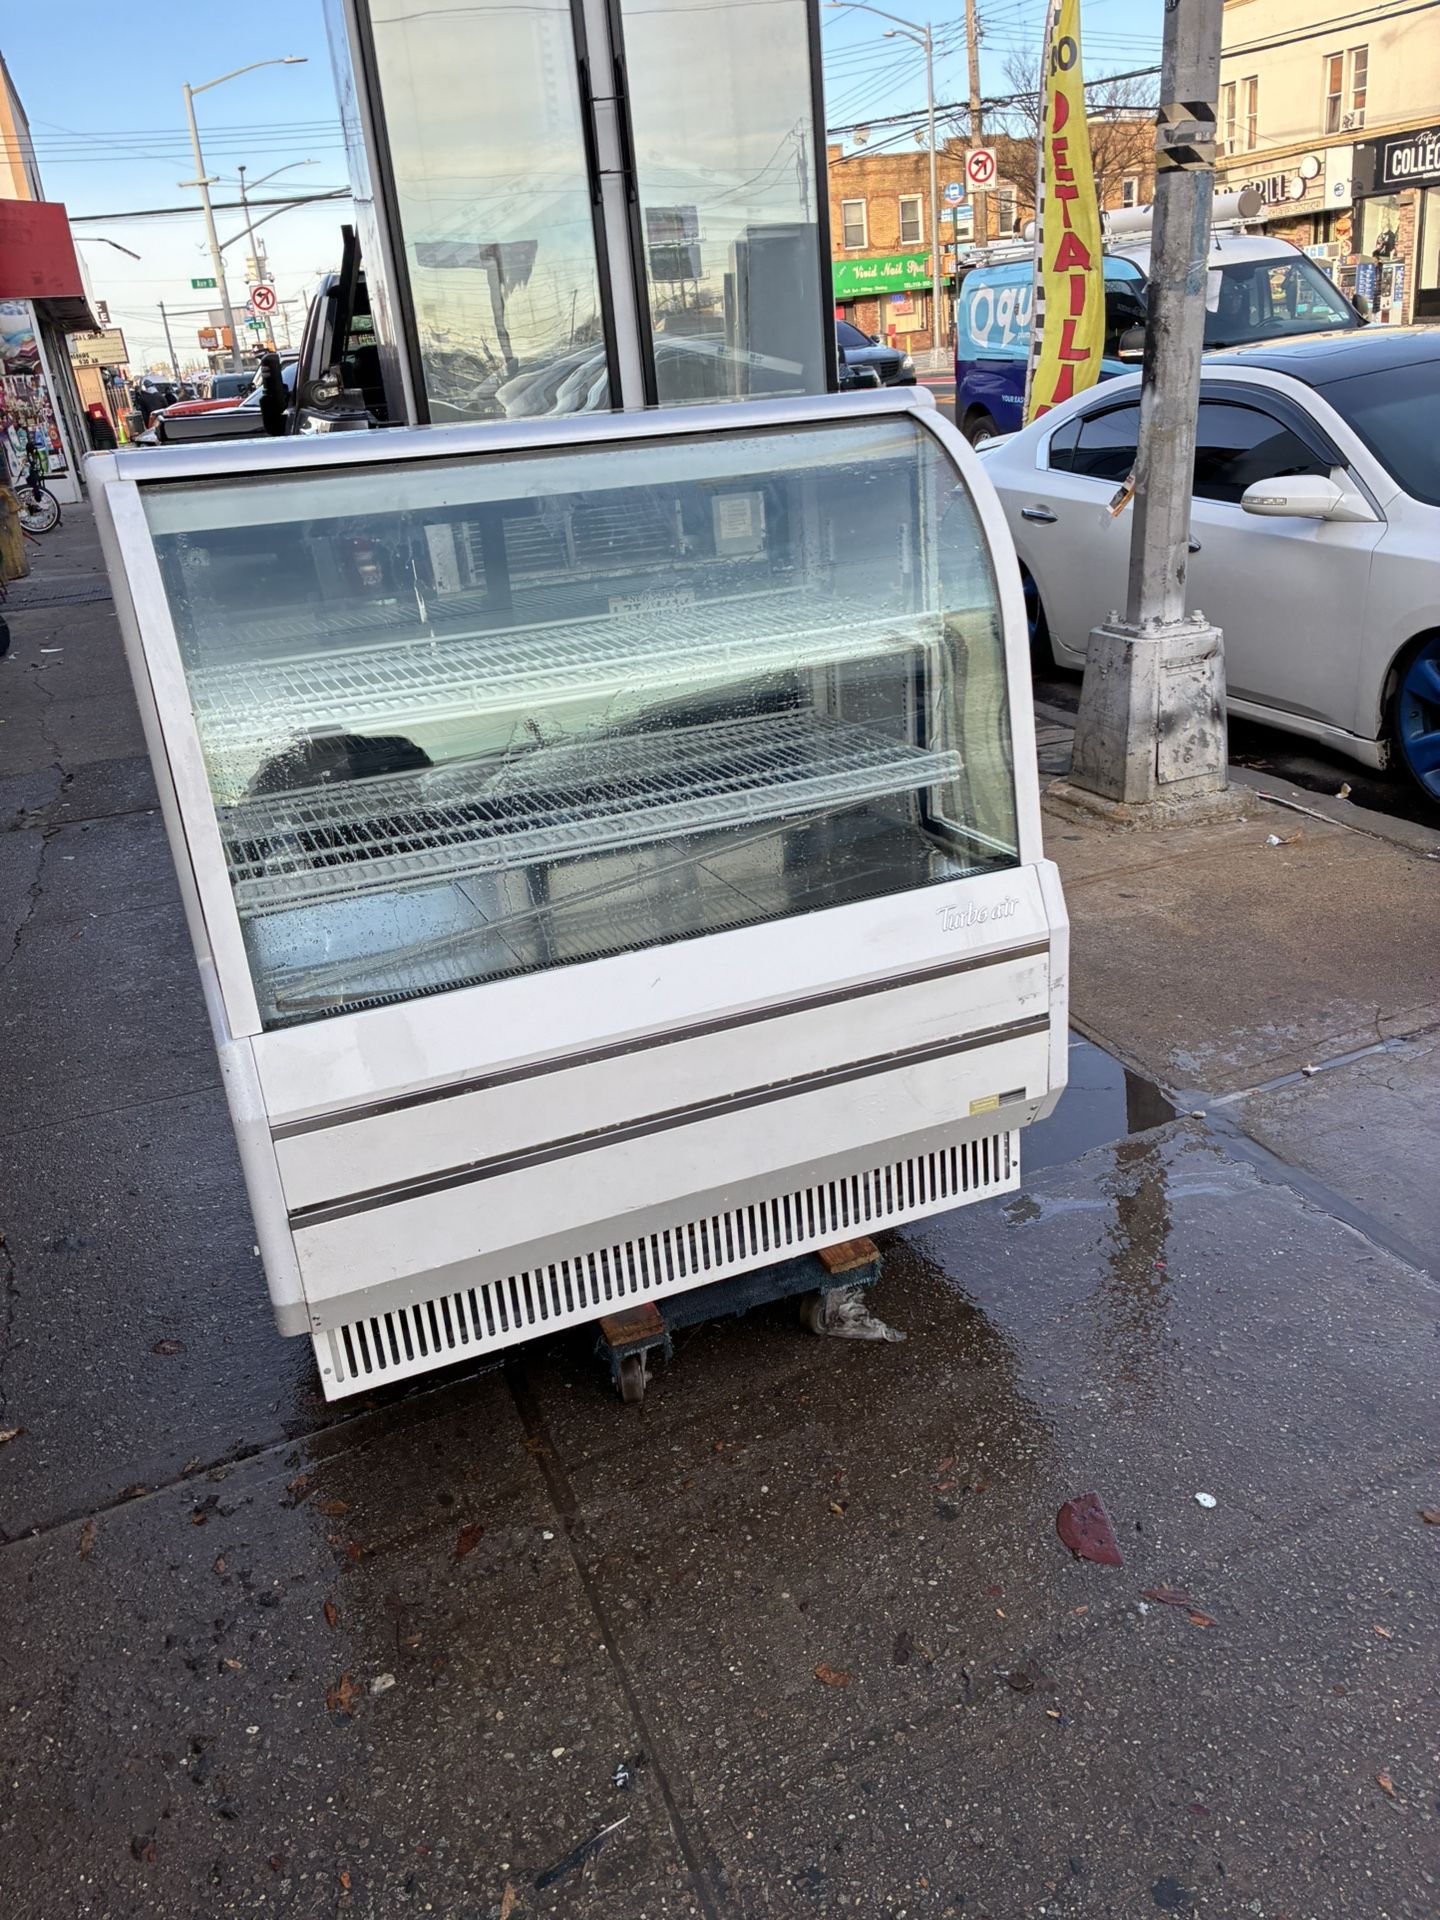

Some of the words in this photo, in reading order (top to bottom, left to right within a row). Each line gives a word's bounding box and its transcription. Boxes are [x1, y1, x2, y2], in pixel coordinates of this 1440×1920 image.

[852, 263, 877, 279] Vivid
[881, 262, 903, 276] Nail
[935, 900, 988, 932] Turbo
[991, 895, 1020, 920] air
